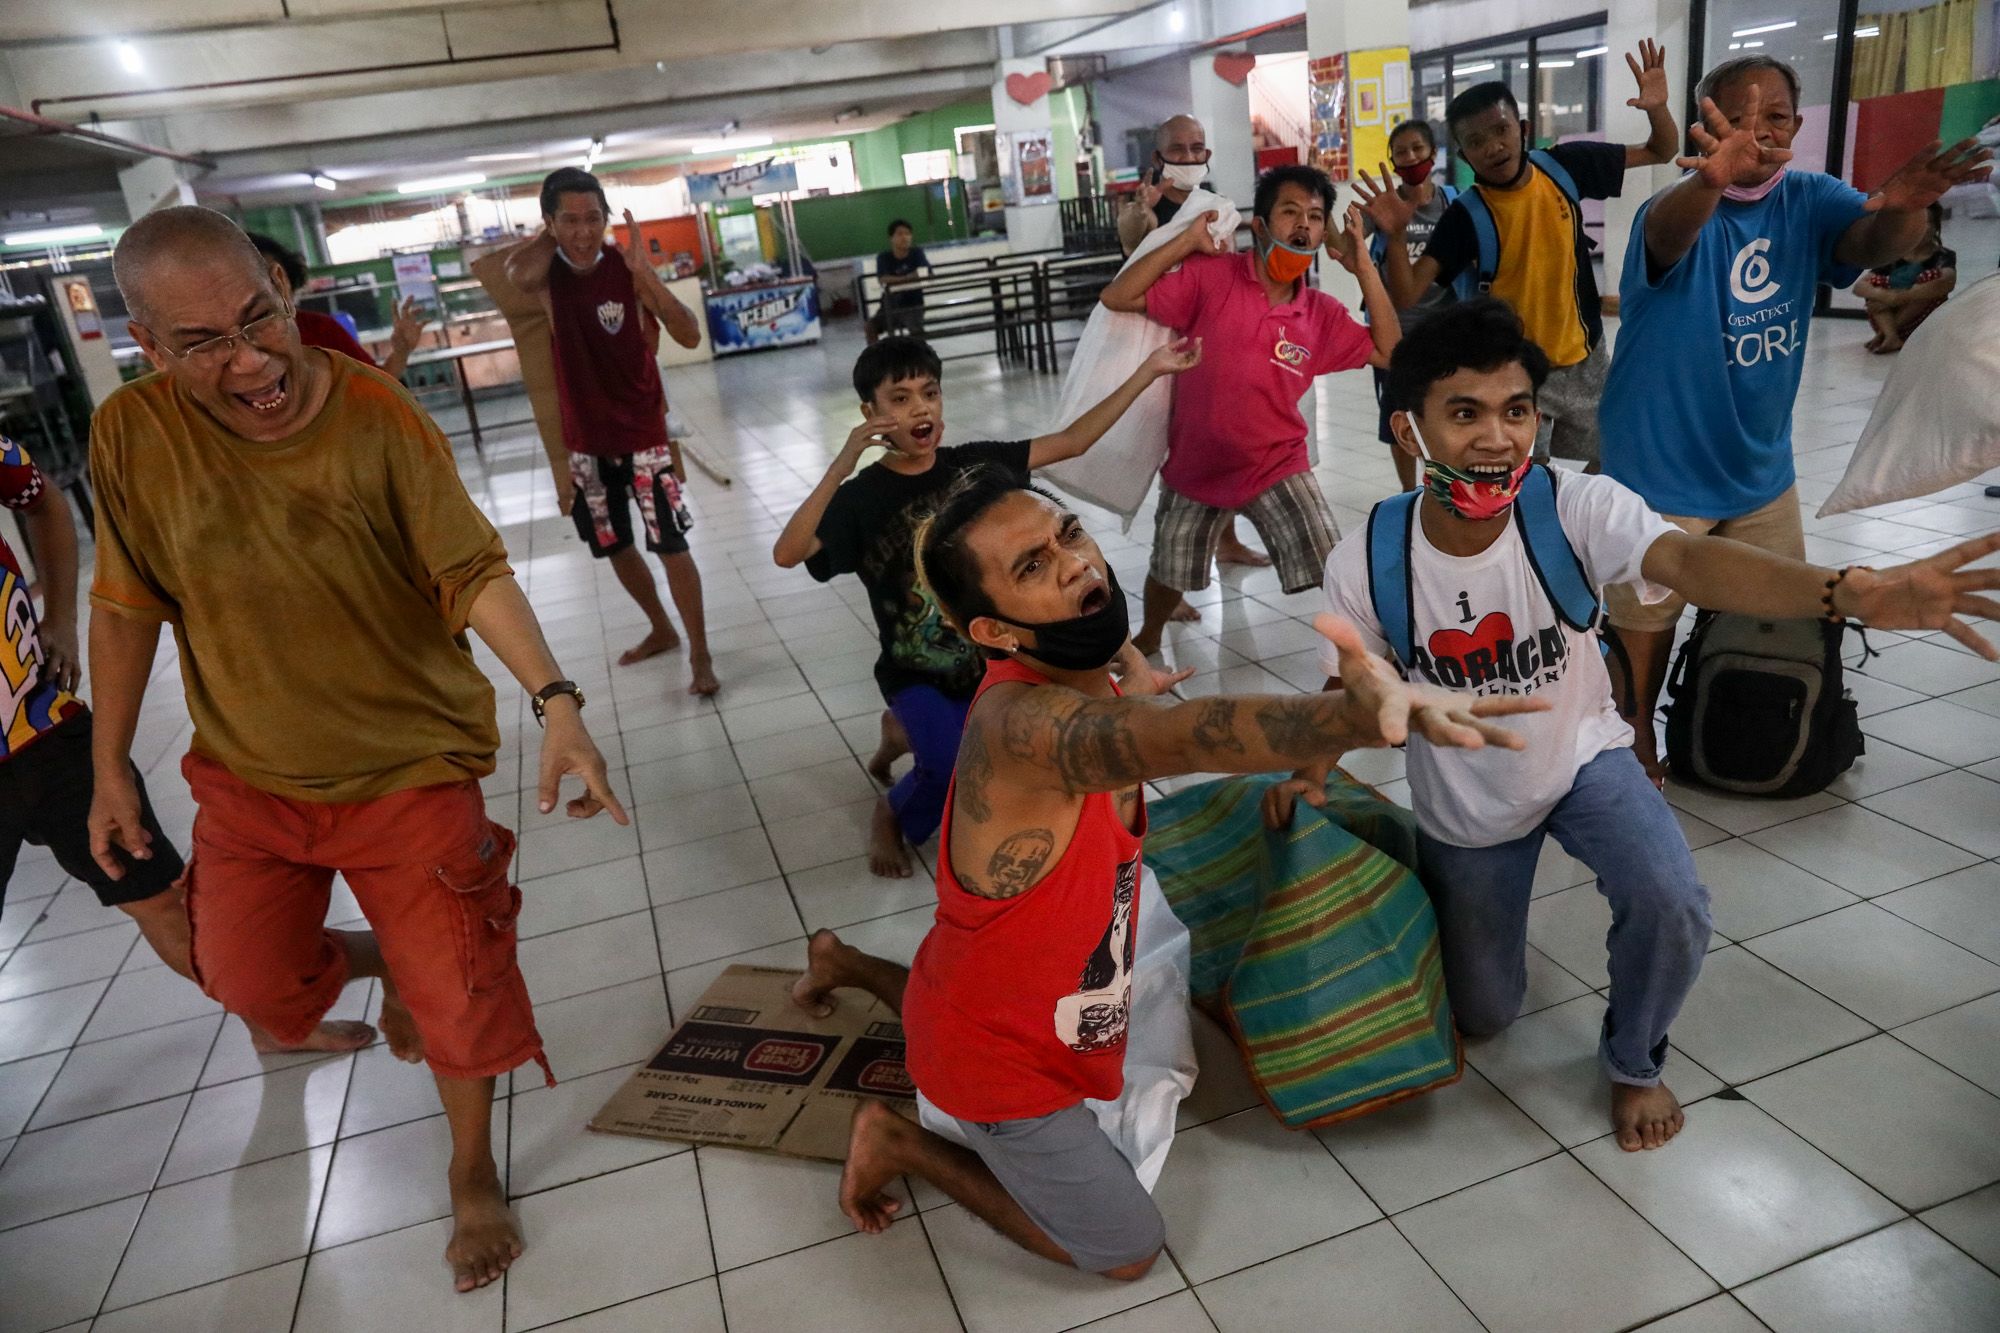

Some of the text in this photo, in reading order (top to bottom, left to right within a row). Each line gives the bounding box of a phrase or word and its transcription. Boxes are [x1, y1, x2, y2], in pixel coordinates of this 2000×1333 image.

[1415, 624, 1567, 689] BORACA
[667, 1043, 740, 1062] WHITE
[755, 1054, 806, 1068] Great
[760, 1045, 812, 1059] Taste
[643, 1090, 767, 1110] HANDLE WITH CARE
